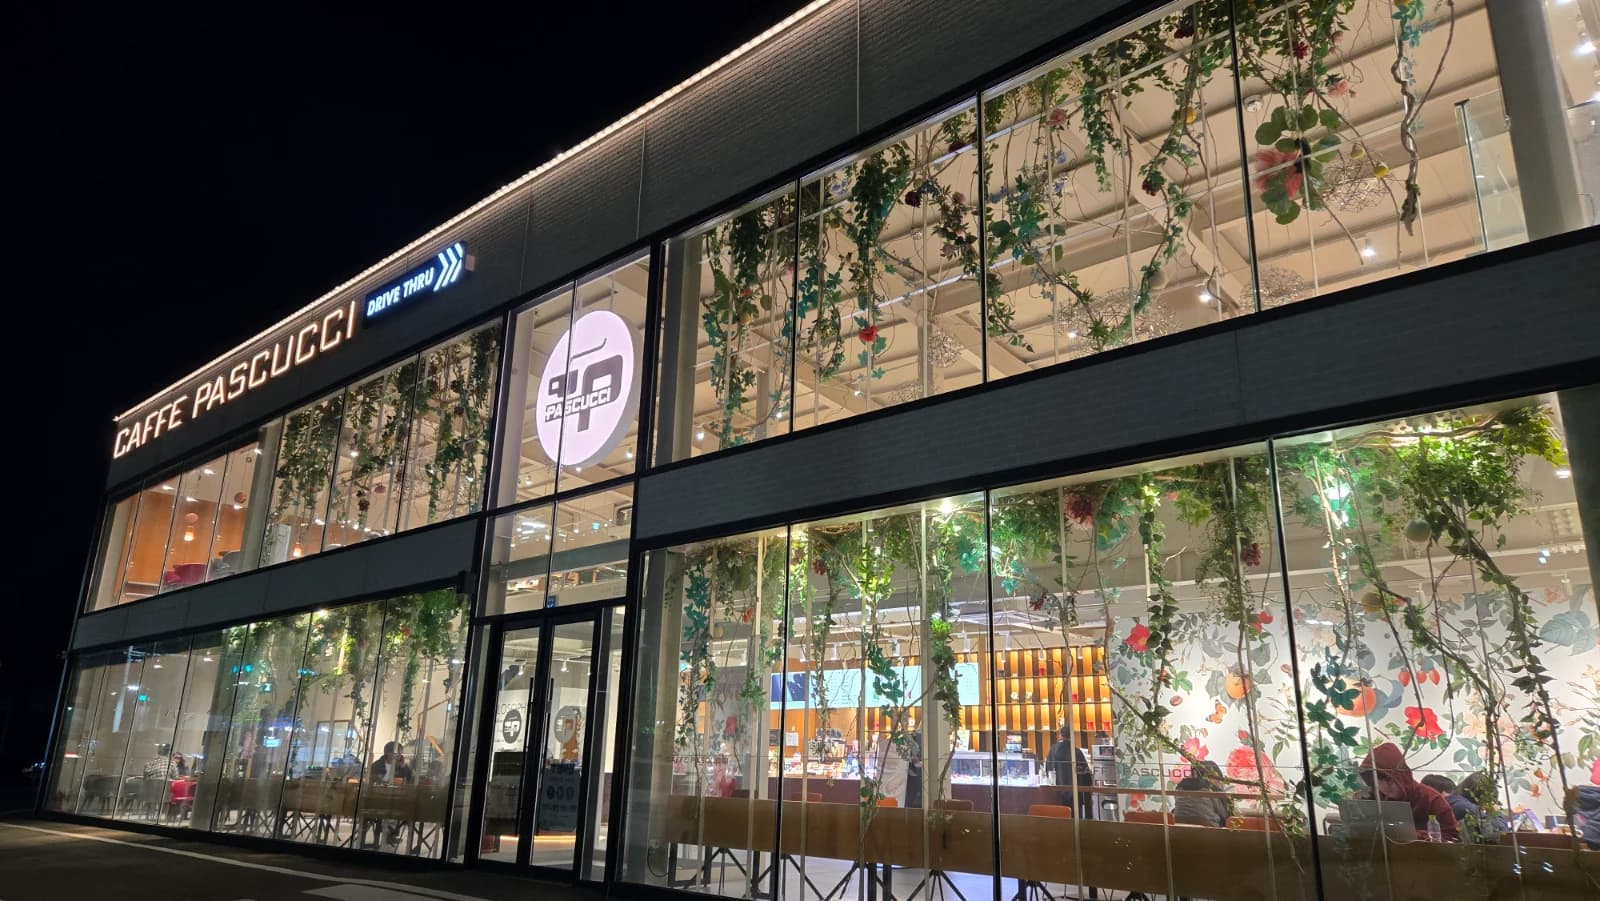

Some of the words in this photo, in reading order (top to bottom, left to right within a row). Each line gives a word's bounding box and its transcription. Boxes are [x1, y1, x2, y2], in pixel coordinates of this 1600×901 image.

[367, 288, 401, 317] DRIVE
[402, 266, 435, 299] THRU
[113, 396, 188, 459] CAFFE
[192, 300, 356, 420] PASCUCCI
[545, 386, 612, 422] PASCUCCI
